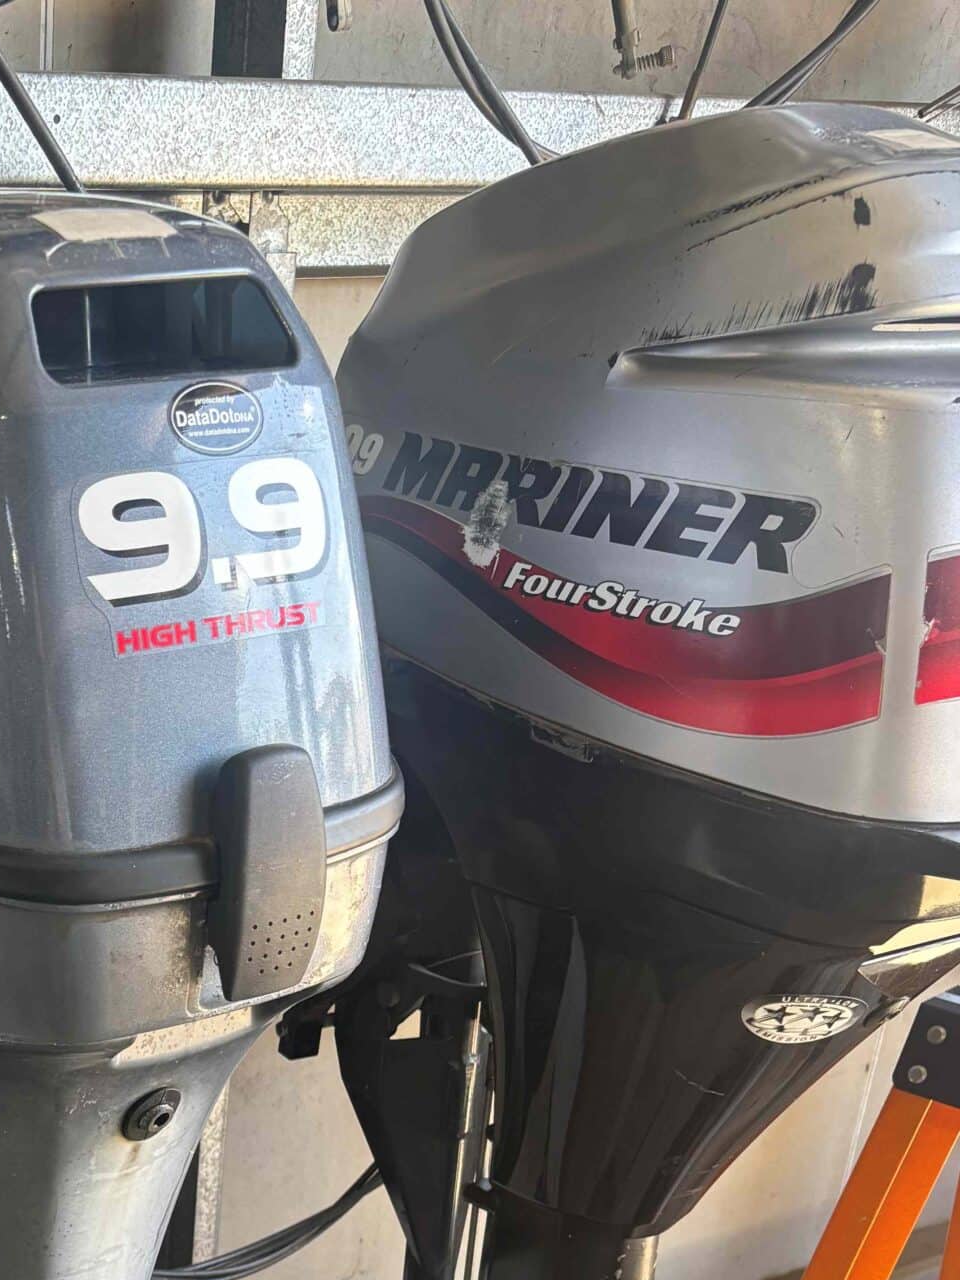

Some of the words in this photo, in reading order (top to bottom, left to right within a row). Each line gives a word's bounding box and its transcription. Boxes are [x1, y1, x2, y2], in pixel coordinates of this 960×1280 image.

[78, 456, 327, 601] 9.9
[381, 431, 818, 575] MARINER
[116, 620, 198, 655] HIGH
[203, 601, 322, 640] THRUST
[503, 561, 742, 637] FourStroke
